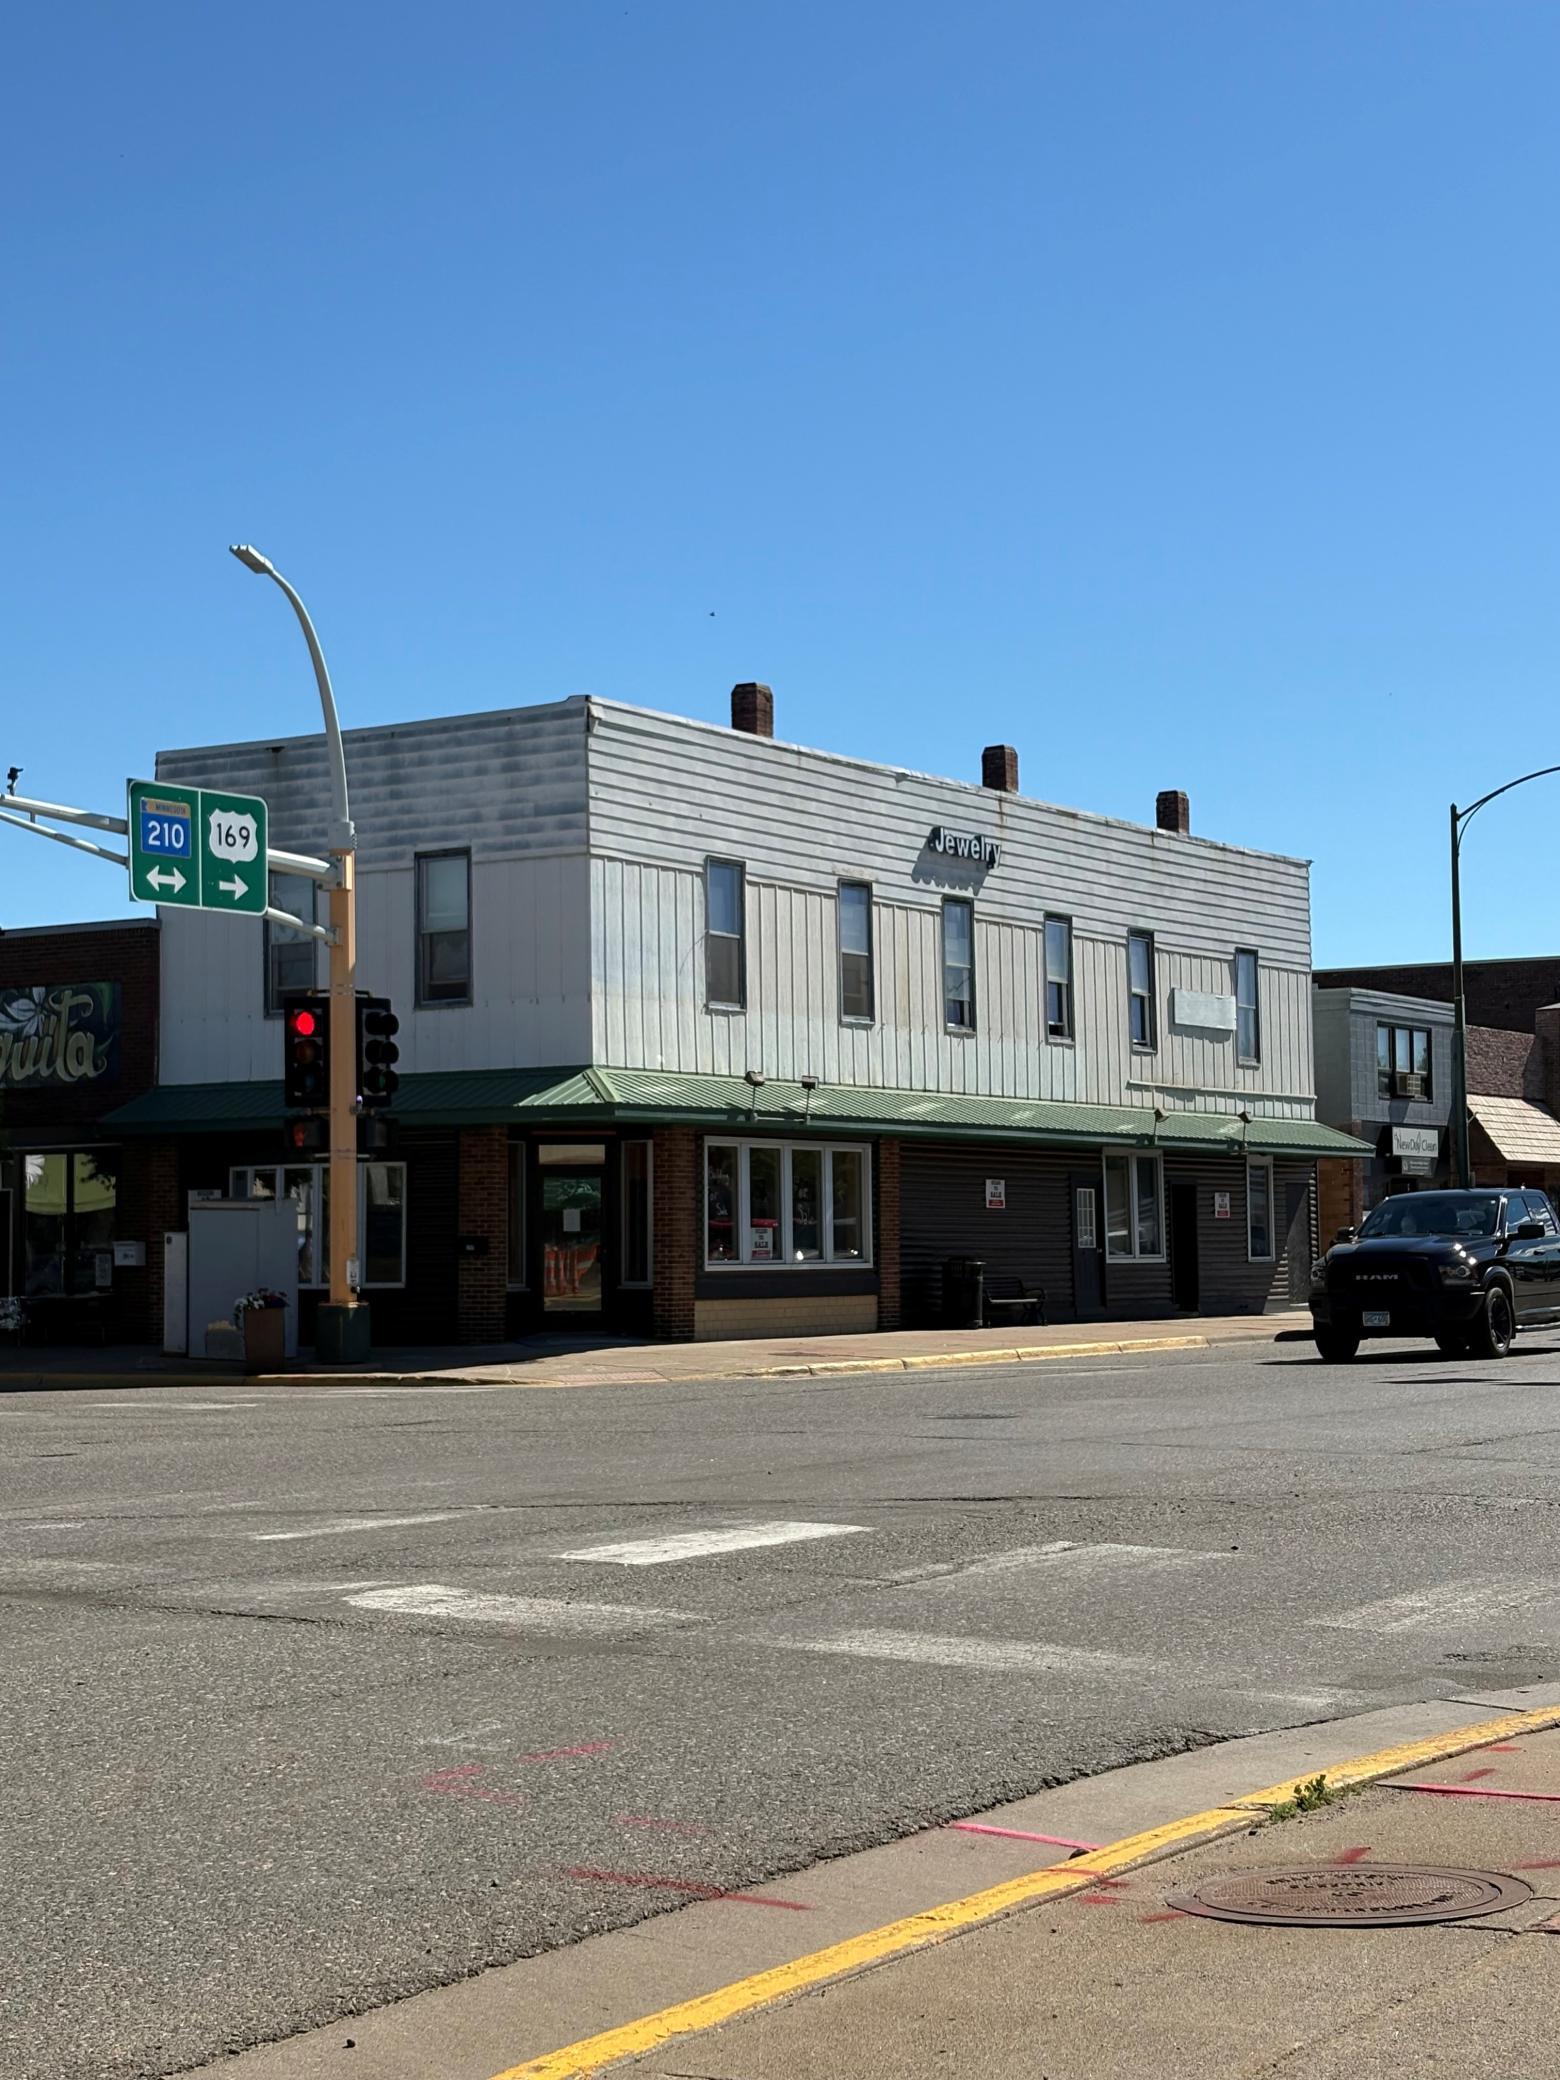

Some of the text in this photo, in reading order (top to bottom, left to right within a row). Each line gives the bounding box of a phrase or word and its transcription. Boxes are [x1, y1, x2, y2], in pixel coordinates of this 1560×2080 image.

[148, 820, 185, 849] 210
[216, 822, 251, 850] 169
[933, 826, 1001, 869] Jewelry
